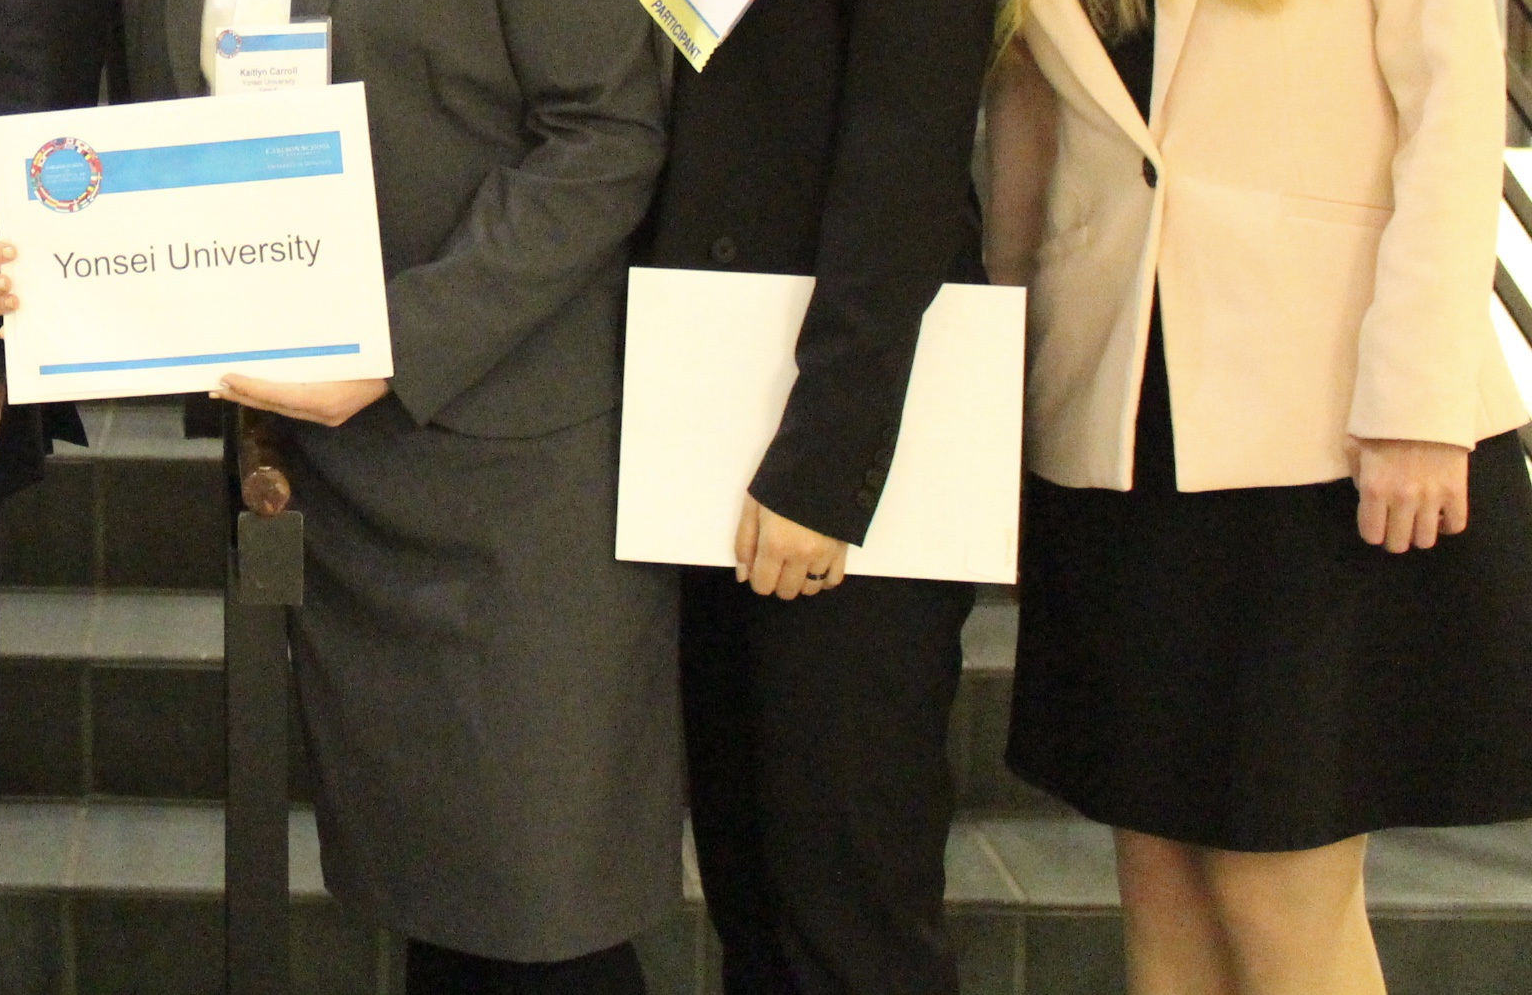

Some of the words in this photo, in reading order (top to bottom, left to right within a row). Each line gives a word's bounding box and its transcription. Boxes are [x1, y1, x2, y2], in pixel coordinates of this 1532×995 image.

[651, 0, 702, 60] PARTICIPANT
[240, 68, 267, 78] Kaitlyn
[269, 67, 298, 75] Carroll
[54, 245, 155, 279] Yonsei
[168, 234, 321, 270] University
